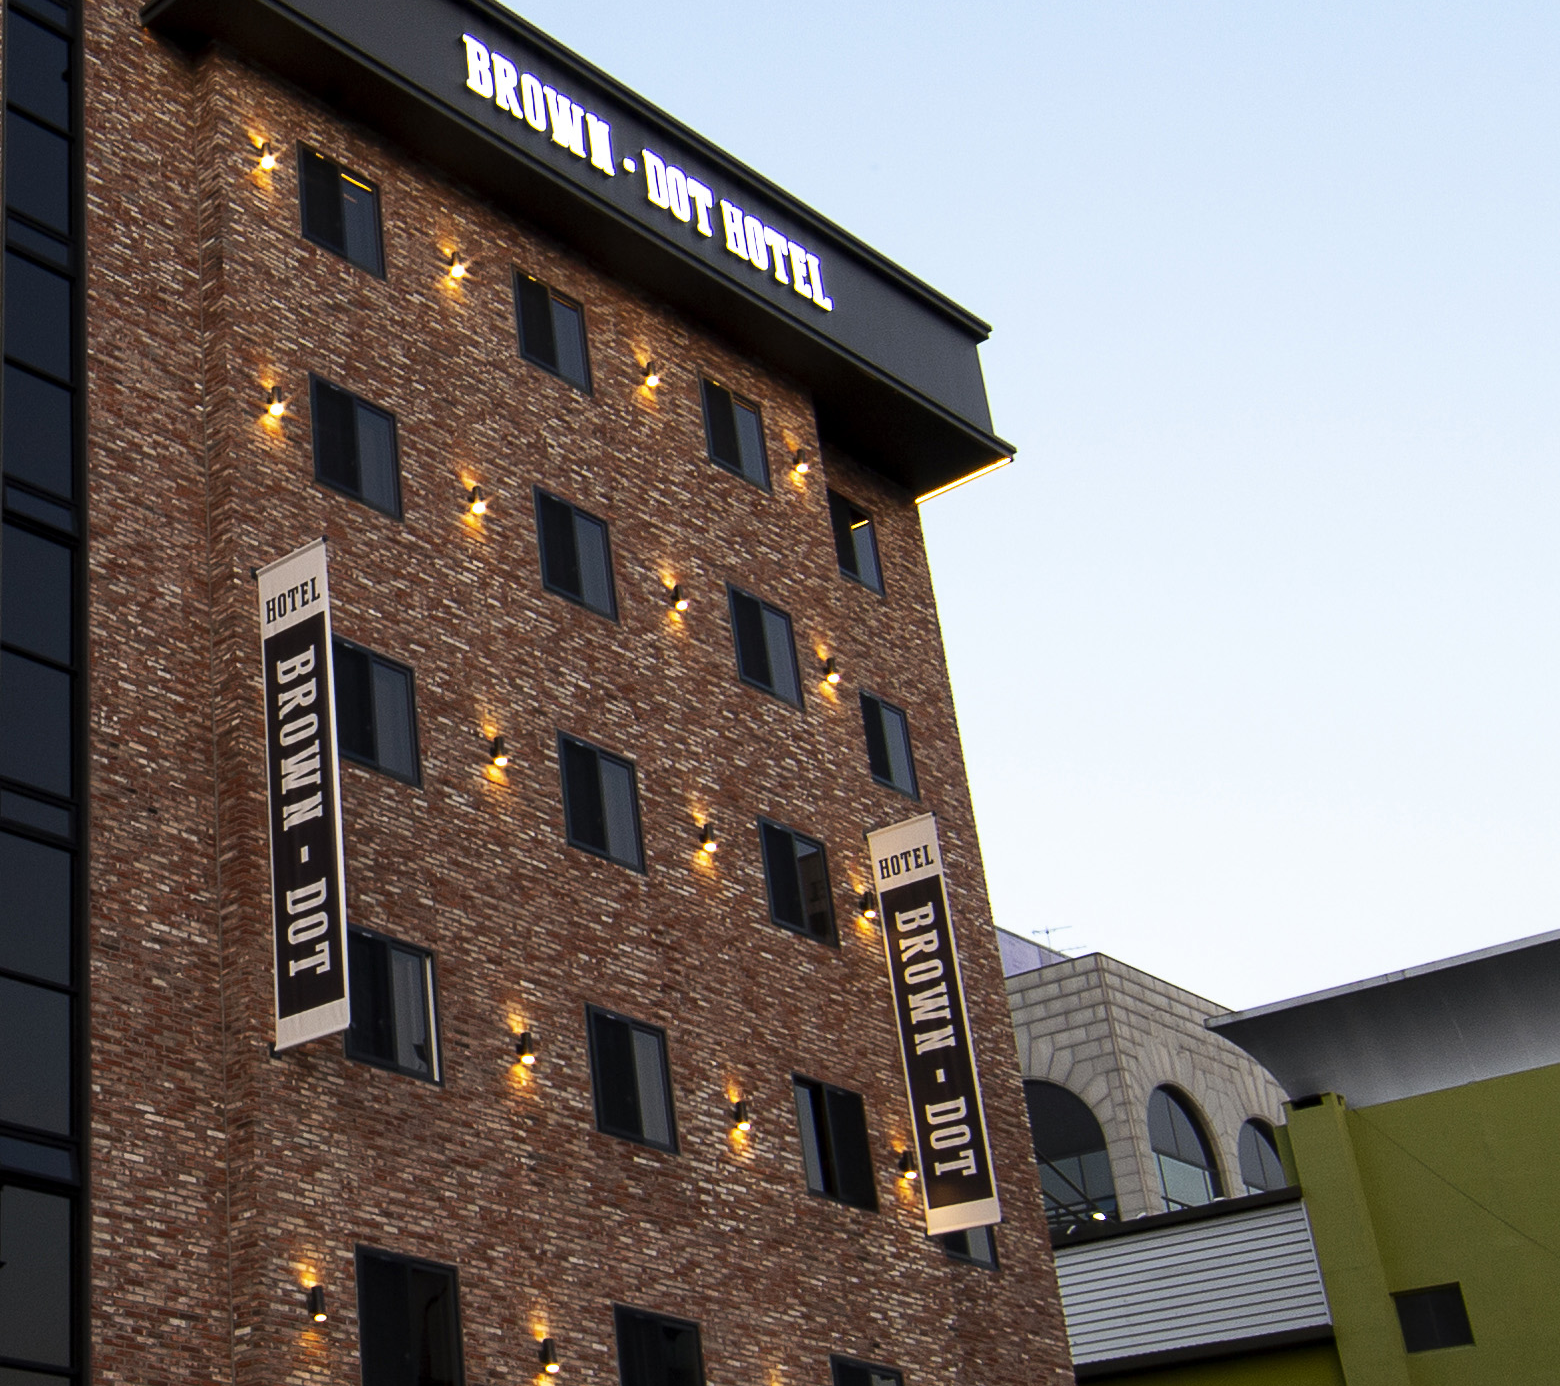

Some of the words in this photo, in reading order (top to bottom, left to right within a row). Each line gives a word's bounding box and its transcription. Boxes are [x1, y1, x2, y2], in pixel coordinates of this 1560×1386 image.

[462, 32, 616, 177] BROWN
[641, 148, 714, 238] DOT
[720, 198, 834, 312] HOTEL
[265, 576, 321, 625] HOTEL
[275, 644, 323, 831] BROWN
[878, 844, 935, 880] HOTEL
[286, 877, 331, 977] DOT
[895, 902, 956, 1056] BROWN
[925, 1096, 978, 1177] DOT
